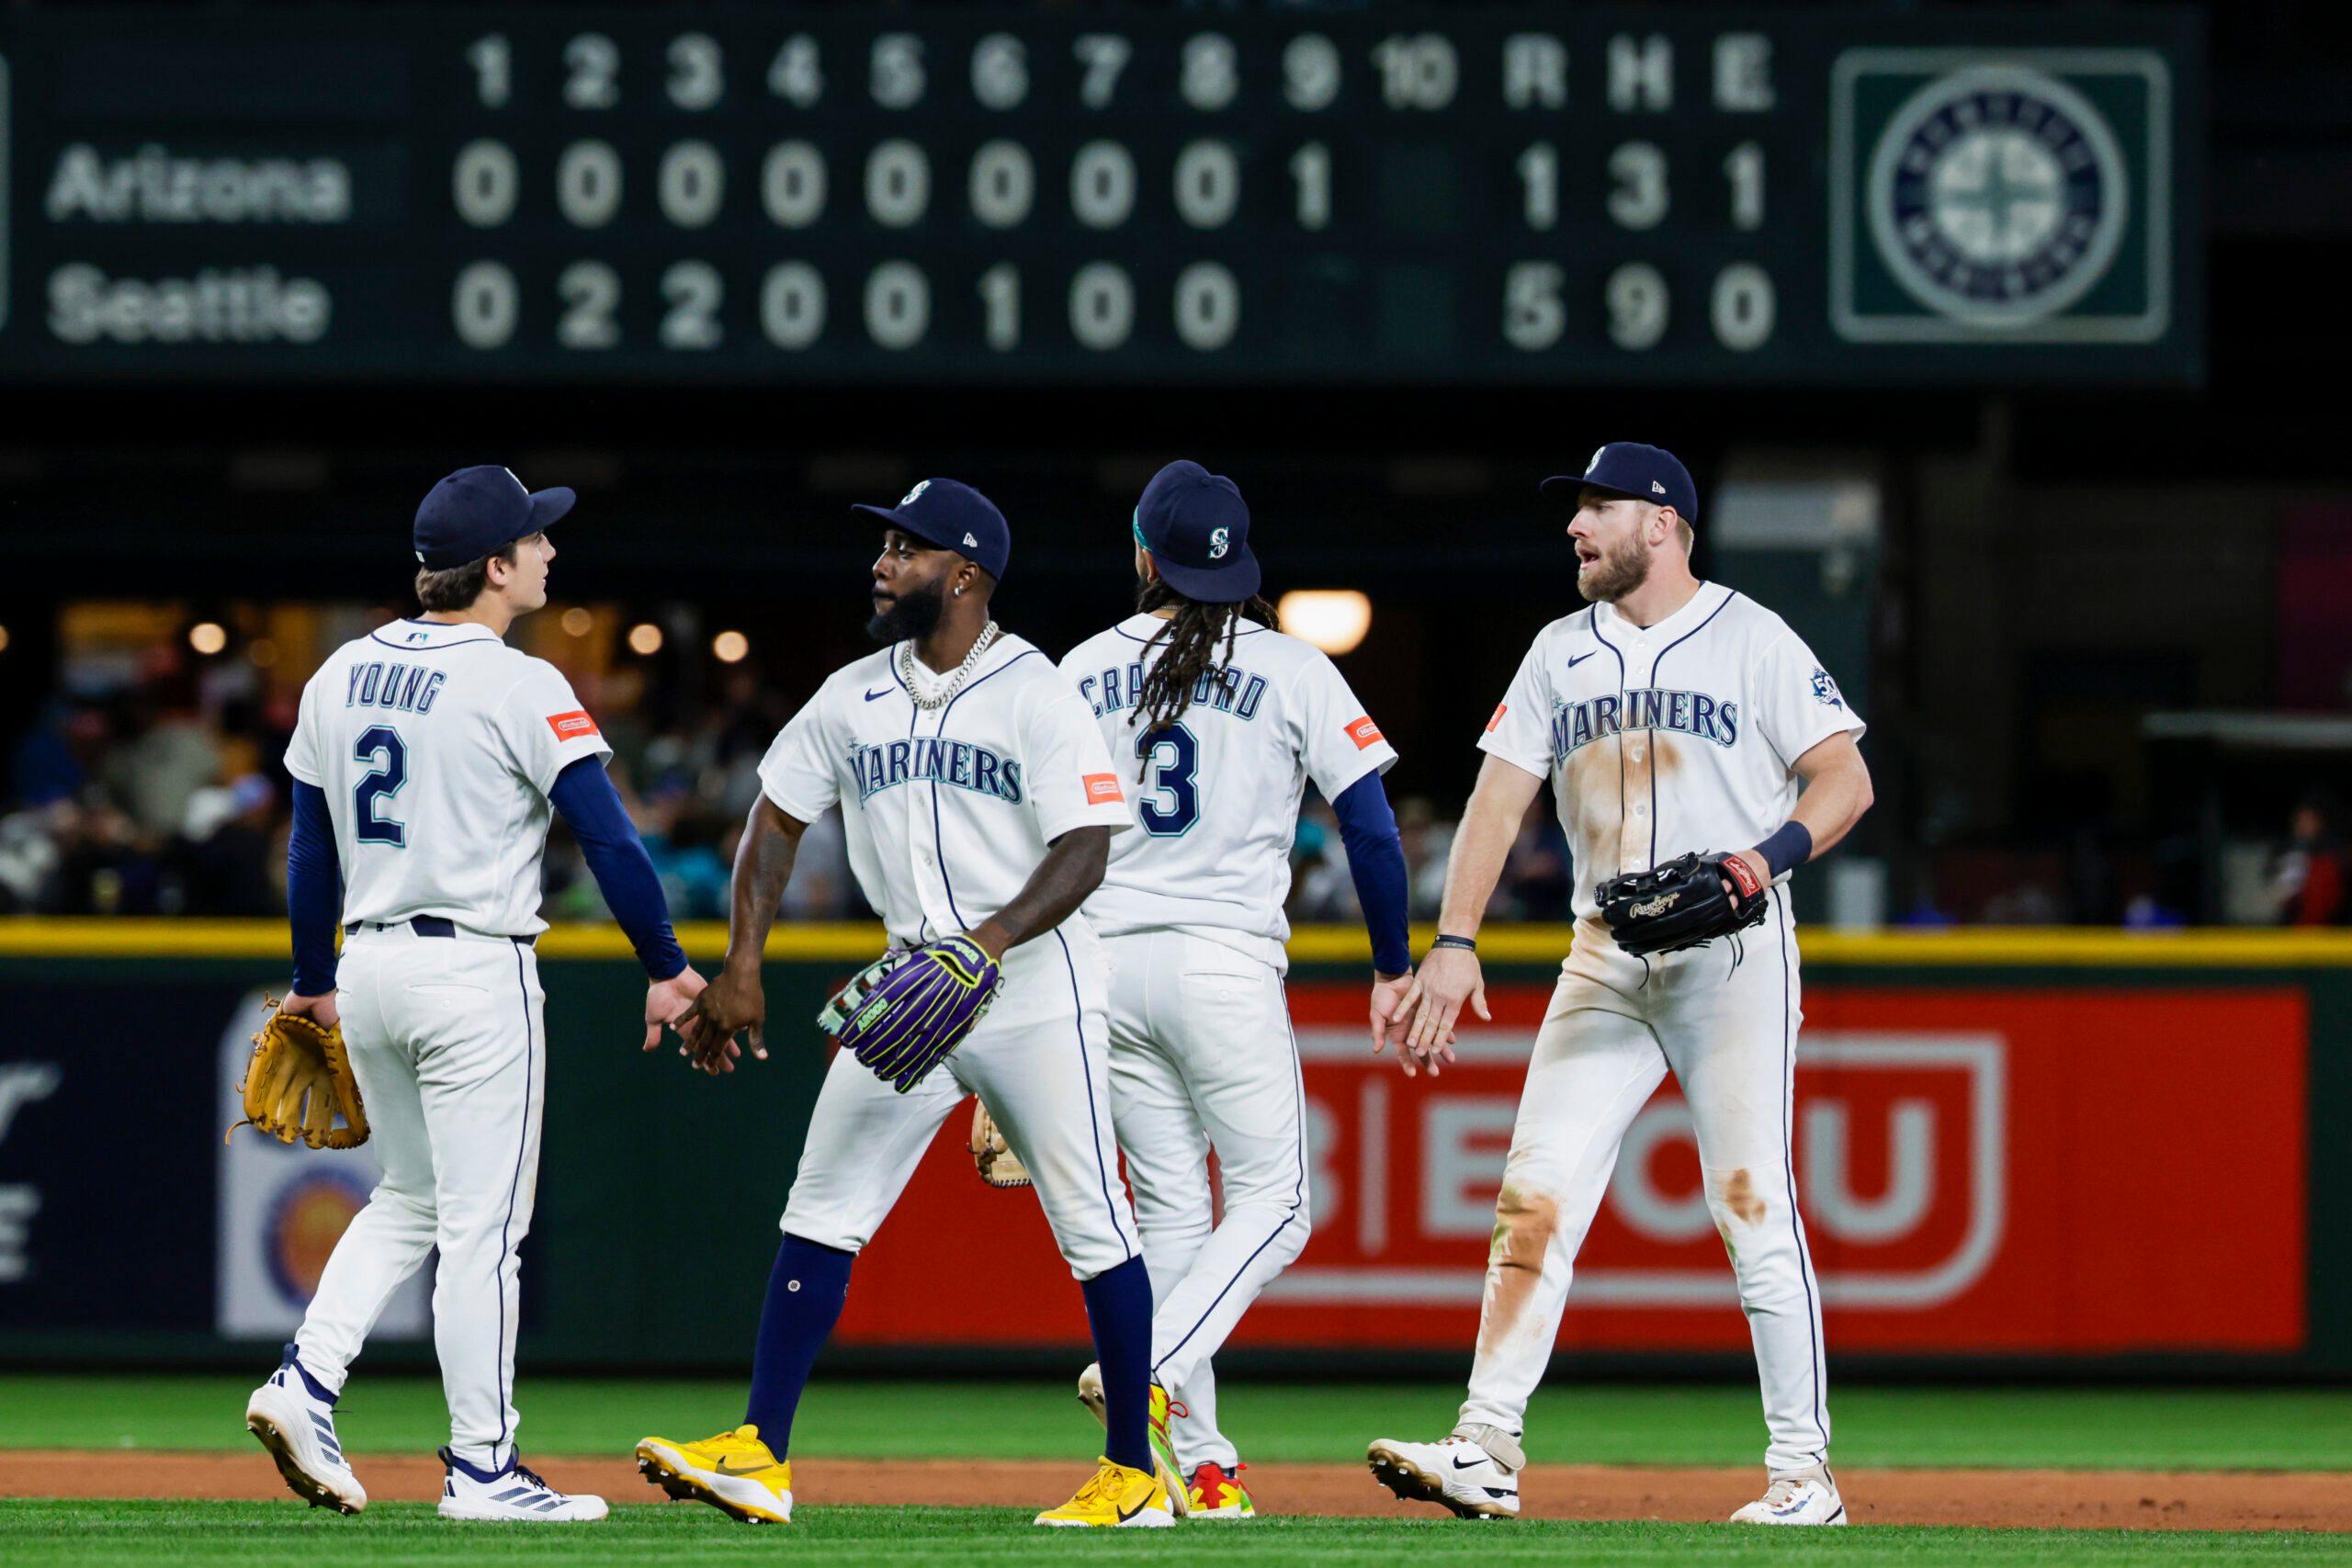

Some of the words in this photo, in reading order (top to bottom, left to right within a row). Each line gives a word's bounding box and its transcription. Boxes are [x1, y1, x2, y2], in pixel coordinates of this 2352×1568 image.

[470, 37, 509, 105] 1
[564, 35, 618, 107] 2
[668, 35, 723, 108] 3
[768, 35, 821, 105] 4
[871, 35, 924, 107] 5
[971, 36, 1028, 107] 6
[1075, 35, 1130, 106] 7
[1182, 35, 1238, 108] 8
[1284, 36, 1340, 108] 9
[1374, 36, 1456, 107] 10
[1504, 35, 1566, 107] R
[1609, 37, 1672, 108] H
[1713, 35, 1773, 110] E
[47, 145, 352, 221] Arizona
[453, 141, 517, 226] 0
[558, 141, 622, 226] 0
[658, 141, 723, 227] 0
[762, 141, 826, 227] 0
[865, 141, 930, 226] 0
[969, 141, 1035, 227] 0
[1070, 141, 1136, 227] 0
[1174, 141, 1239, 227] 0
[1291, 143, 1329, 228] 1
[1518, 143, 1558, 228] 1
[1608, 142, 1668, 229] 3
[1725, 143, 1764, 228] 1
[48, 264, 331, 343] Seattle
[453, 262, 518, 348] 0
[559, 262, 620, 348] 2
[661, 261, 722, 348] 2
[761, 262, 826, 348] 0
[865, 262, 930, 348] 0
[978, 264, 1020, 350] 1
[1069, 263, 1135, 349] 0
[1174, 263, 1239, 349] 0
[1505, 263, 1565, 349] 5
[1607, 264, 1668, 349] 9
[1711, 264, 1776, 351] 0
[1207, 526, 1230, 558] S
[345, 660, 447, 716] YOUNG
[1078, 660, 1270, 721] CRAORD
[1552, 688, 1737, 768] MARINERS
[353, 724, 408, 848] 2
[847, 736, 1023, 809] MARINERS
[1134, 721, 1200, 838] 3
[1629, 891, 1680, 919] Rawlings
